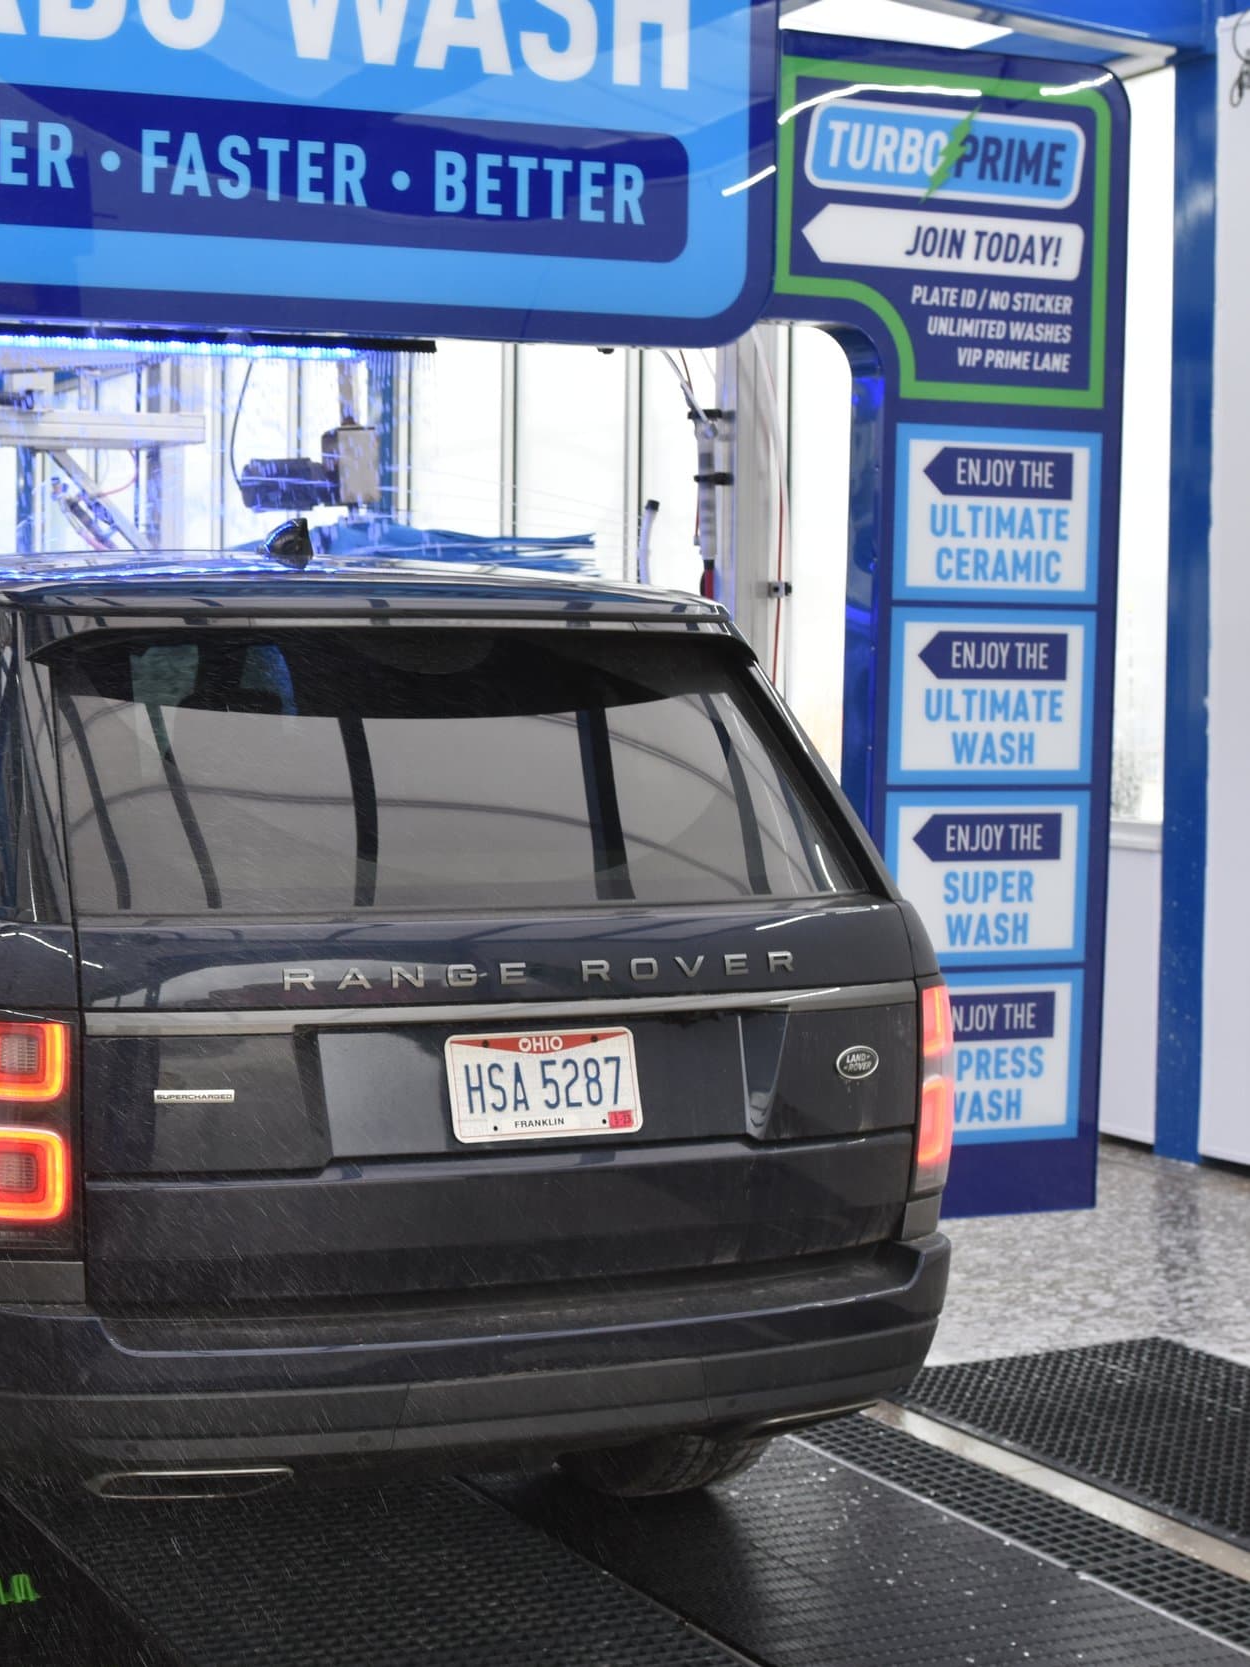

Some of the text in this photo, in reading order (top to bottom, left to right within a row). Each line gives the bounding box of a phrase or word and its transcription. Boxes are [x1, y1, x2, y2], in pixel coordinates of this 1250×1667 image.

[827, 120, 1067, 188] TURBO PRIME
[140, 129, 367, 207] FASTER
[434, 151, 646, 227] BETTER
[905, 225, 1063, 267] JOIN TODAY!
[911, 285, 958, 308] PLATE
[960, 288, 976, 308] ID
[988, 290, 1010, 311] NO
[1011, 291, 1073, 315] STICKER
[927, 316, 1072, 344] UNLIMITED WASHES
[957, 347, 1071, 373] VIP PRIME LANE
[956, 457, 1054, 489] ENJOY THE
[930, 503, 1070, 541] ULTIMATE
[935, 547, 1062, 584] CERAMIC
[951, 641, 1049, 670] ENJOY THE
[924, 688, 1064, 723] ULTIMATE
[951, 732, 1035, 765] WASH
[945, 823, 1042, 852] ENJOY THE
[943, 870, 1034, 904] SUPER
[945, 912, 1029, 946] WASH
[282, 950, 795, 992] RANGE ROVER
[951, 1003, 1037, 1032] NJOY THE
[518, 1035, 564, 1053] OHIO
[846, 1053, 867, 1064] LAND
[956, 1045, 1044, 1081] PRESS
[156, 1093, 233, 1101] SUPERCHARGED
[464, 1056, 621, 1114] HSA 5287
[514, 1117, 565, 1128] FRANKLIN
